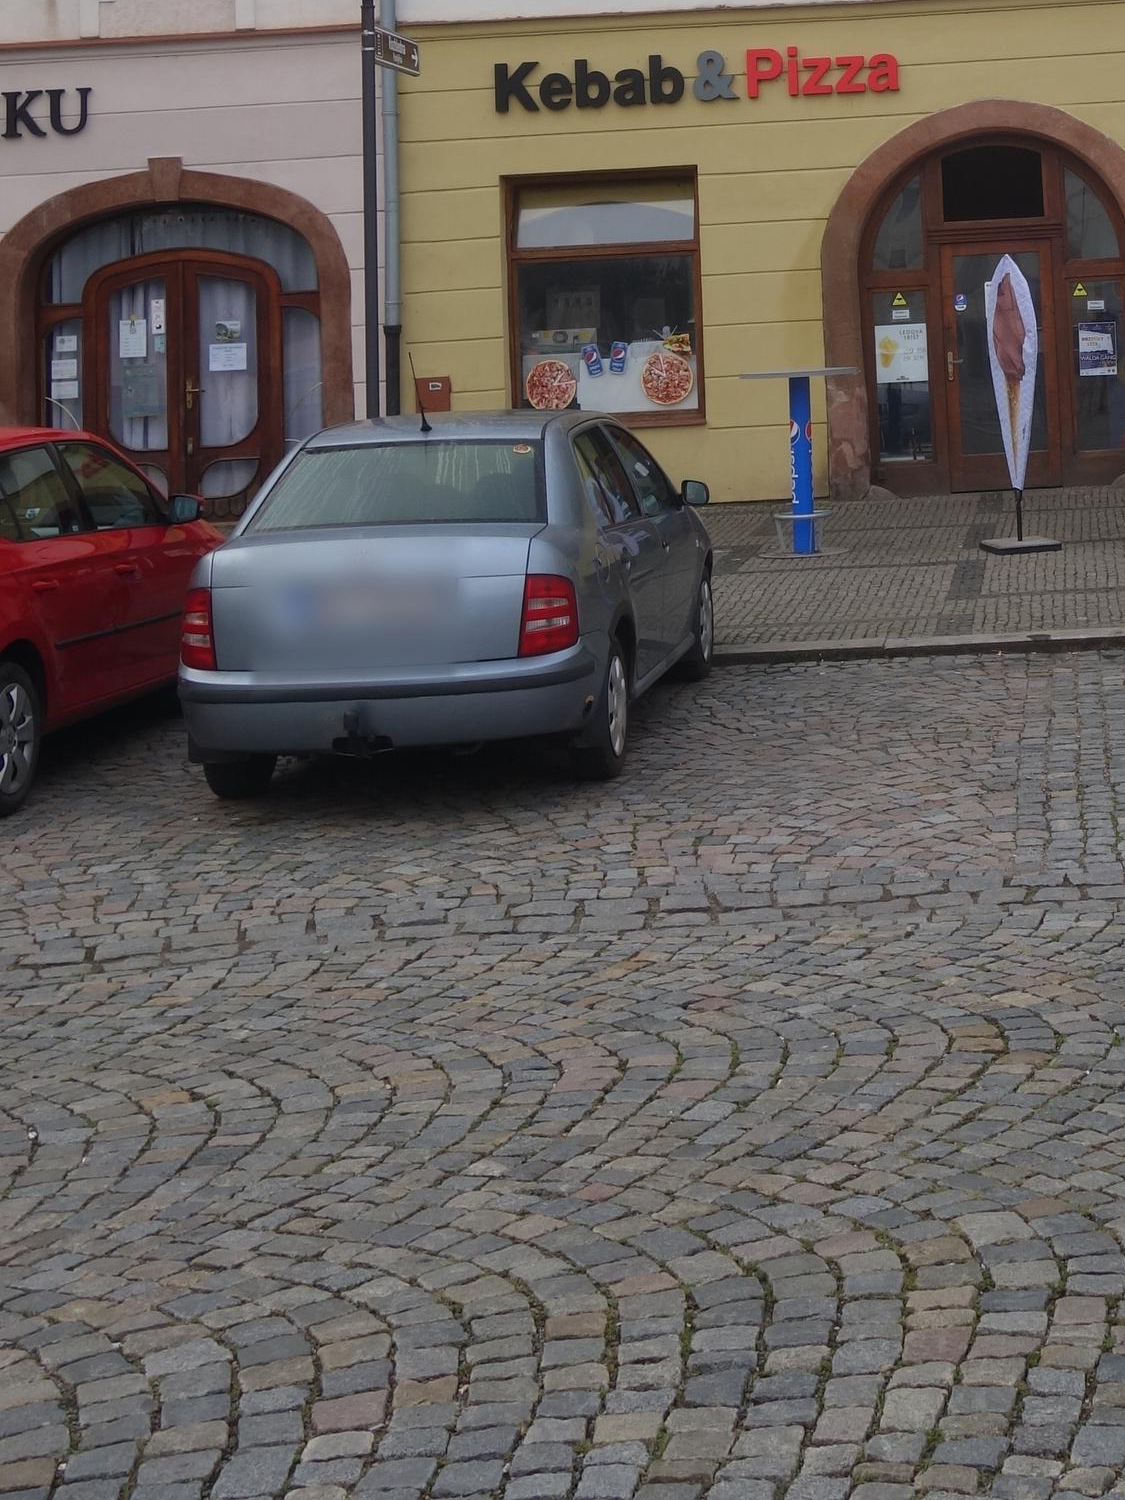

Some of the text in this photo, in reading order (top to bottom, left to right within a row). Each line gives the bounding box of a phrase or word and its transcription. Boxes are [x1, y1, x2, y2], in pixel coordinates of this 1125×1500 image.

[493, 46, 901, 113] Kebab & Pizza
[1, 87, 92, 138] KU
